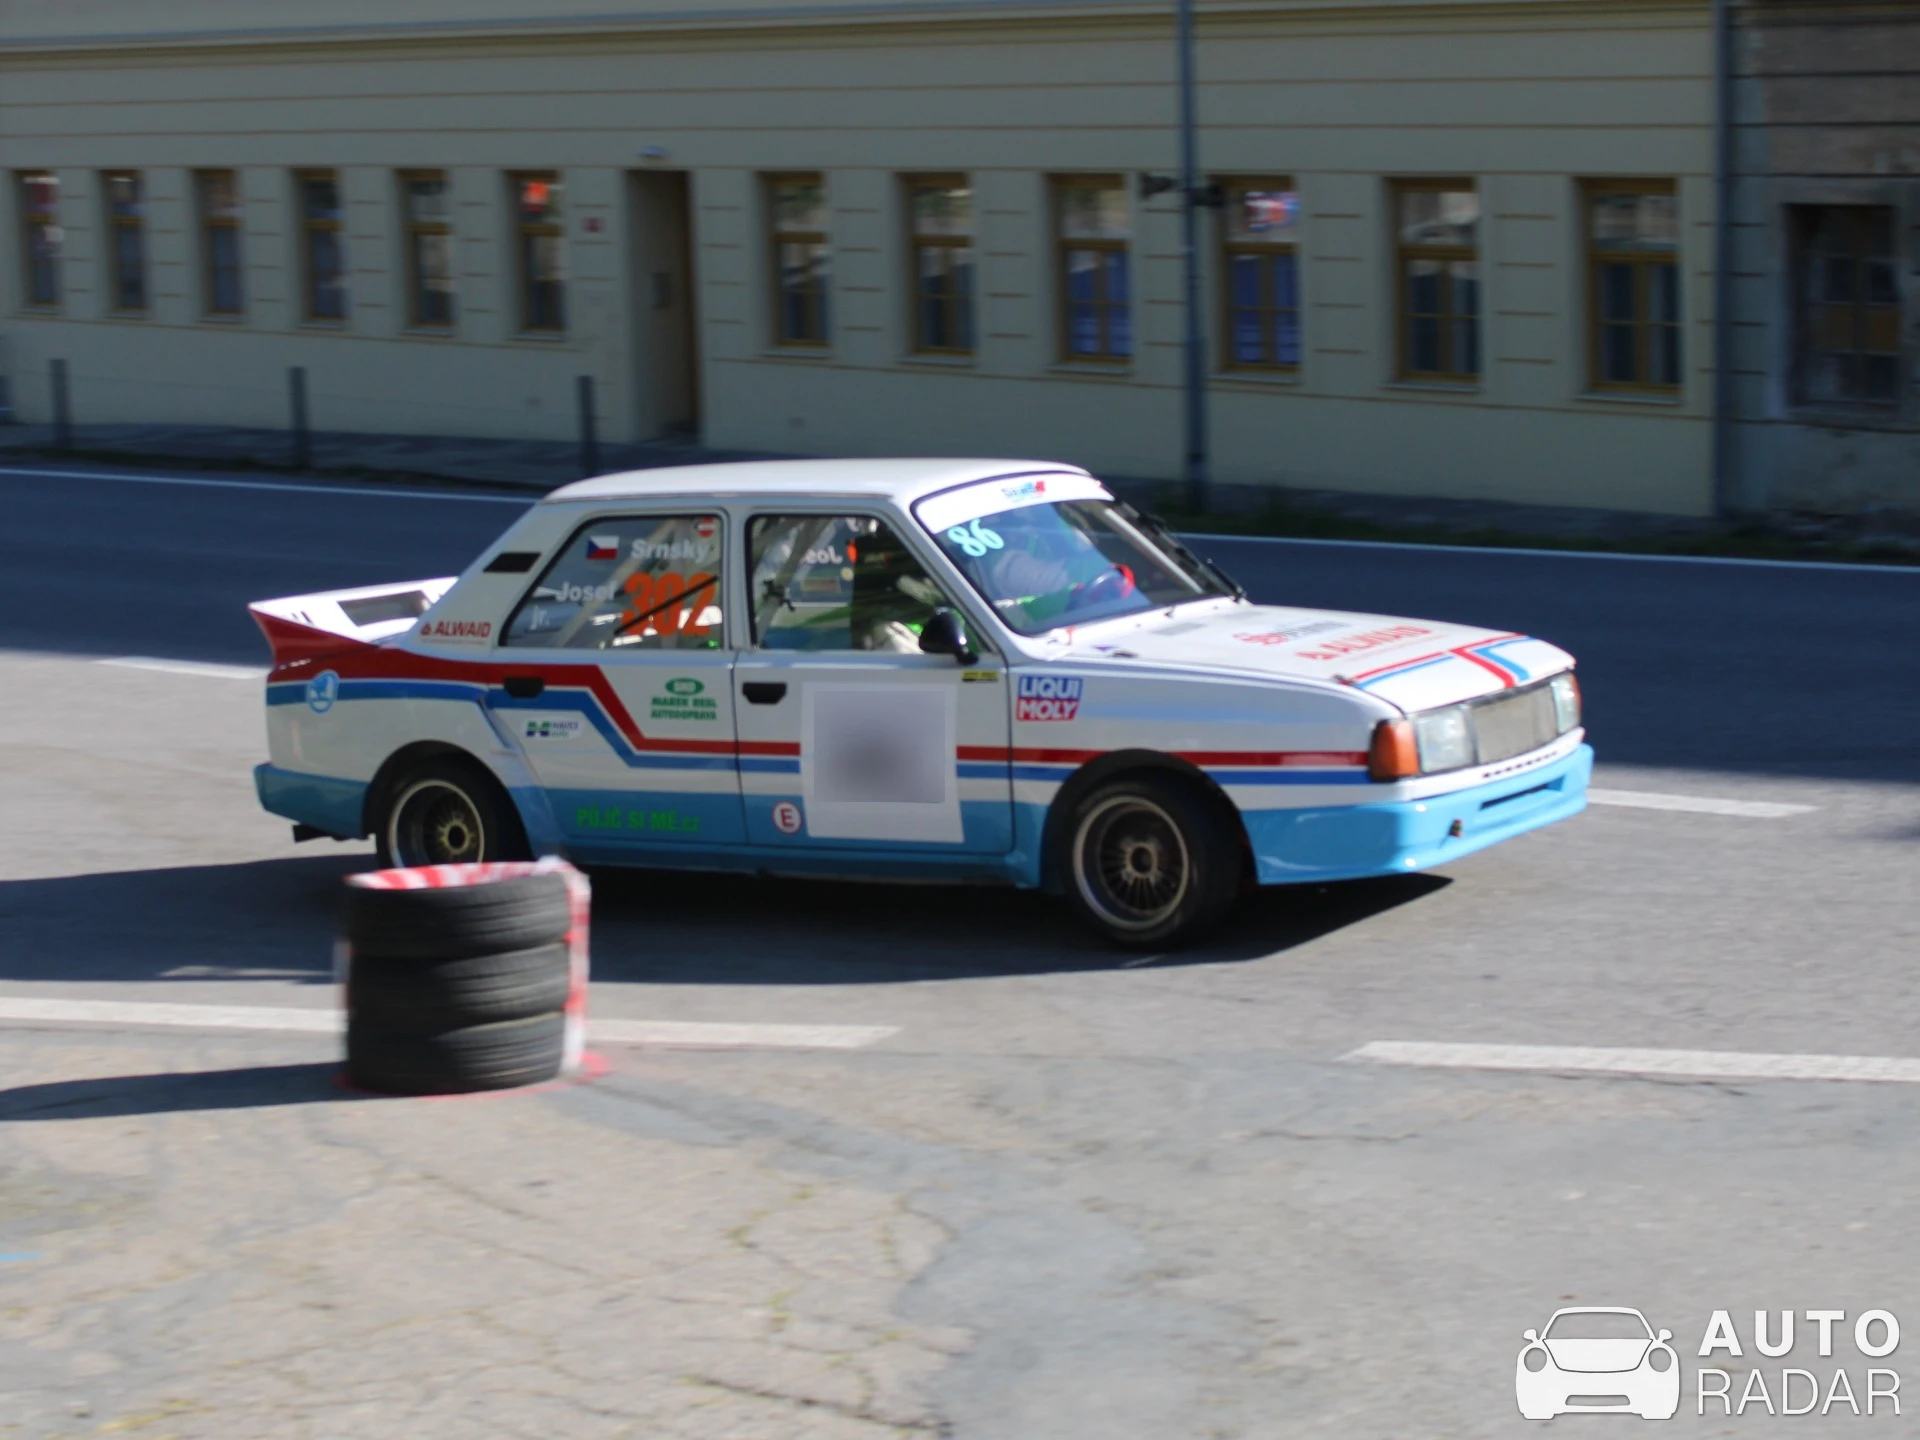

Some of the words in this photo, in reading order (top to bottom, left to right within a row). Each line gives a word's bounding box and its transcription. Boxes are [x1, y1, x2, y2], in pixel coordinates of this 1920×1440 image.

[947, 518, 1004, 557] 86
[556, 581, 617, 601] Josef
[621, 572, 717, 636] 302
[435, 620, 492, 638] ALWAID
[1021, 678, 1080, 698] LIQUI
[1019, 699, 1077, 719] MOLY
[627, 809, 644, 830] SI
[780, 808, 795, 828] E
